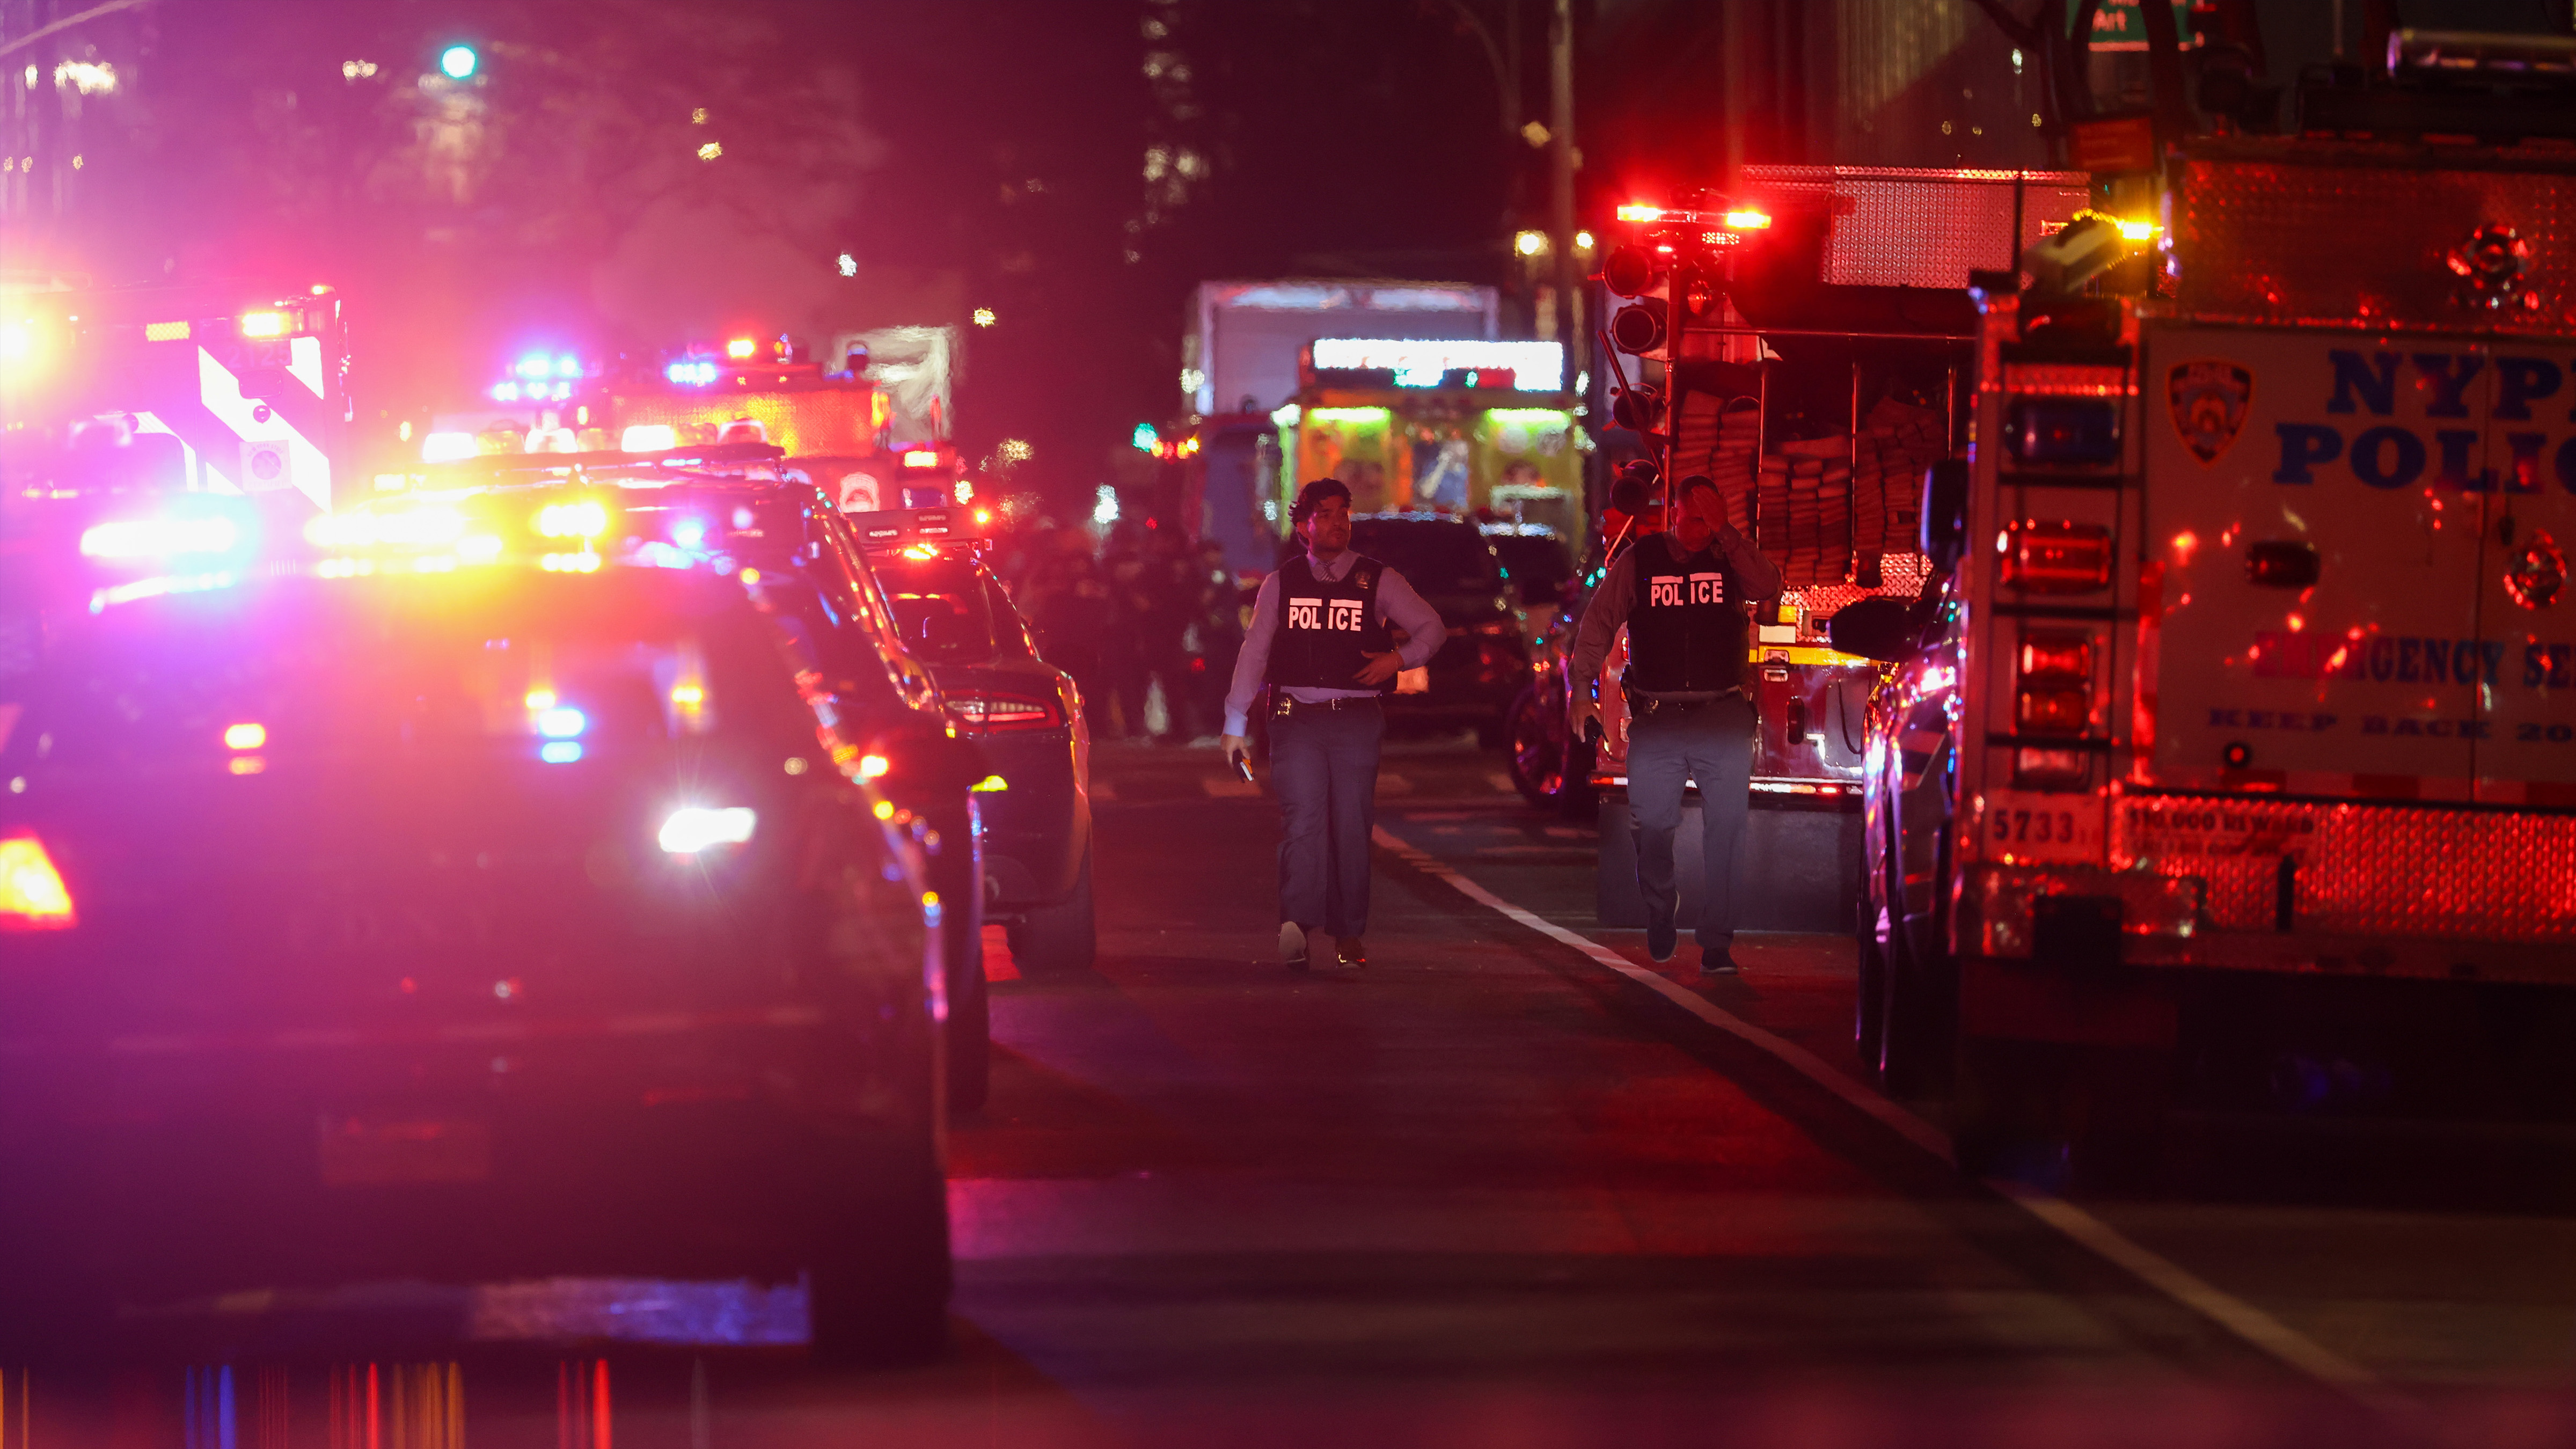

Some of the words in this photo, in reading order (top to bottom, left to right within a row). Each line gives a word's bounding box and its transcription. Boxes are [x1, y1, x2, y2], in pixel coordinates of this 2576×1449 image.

[2092, 9, 2127, 32] Art
[2327, 349, 2576, 422] NYP
[2523, 644, 2576, 689] SE
[2209, 708, 2338, 732] KEEP
[2363, 714, 2492, 739] BACK
